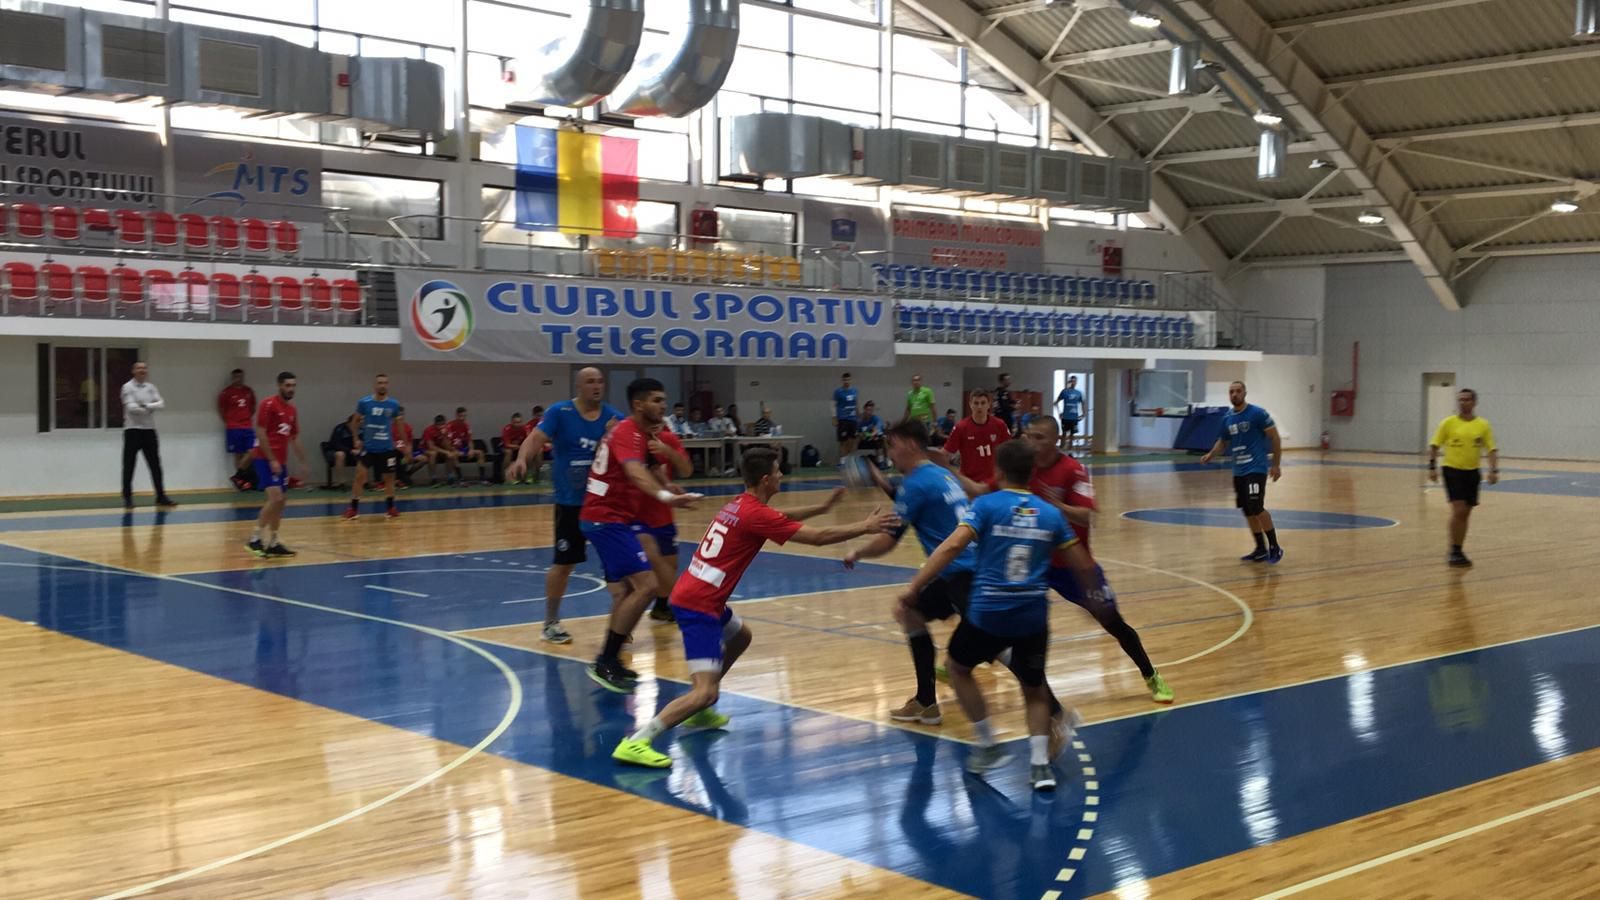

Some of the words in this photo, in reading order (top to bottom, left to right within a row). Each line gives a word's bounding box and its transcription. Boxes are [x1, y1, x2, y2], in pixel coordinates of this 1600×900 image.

[0, 125, 86, 160] ERUL
[16, 166, 154, 203] SPORTULUI
[232, 163, 310, 196] MTS
[487, 281, 680, 319] CLUBUL
[692, 292, 882, 327] SPORTIV
[541, 324, 848, 360] TELEORMAN
[976, 444, 991, 457] 11
[697, 518, 729, 559] 5
